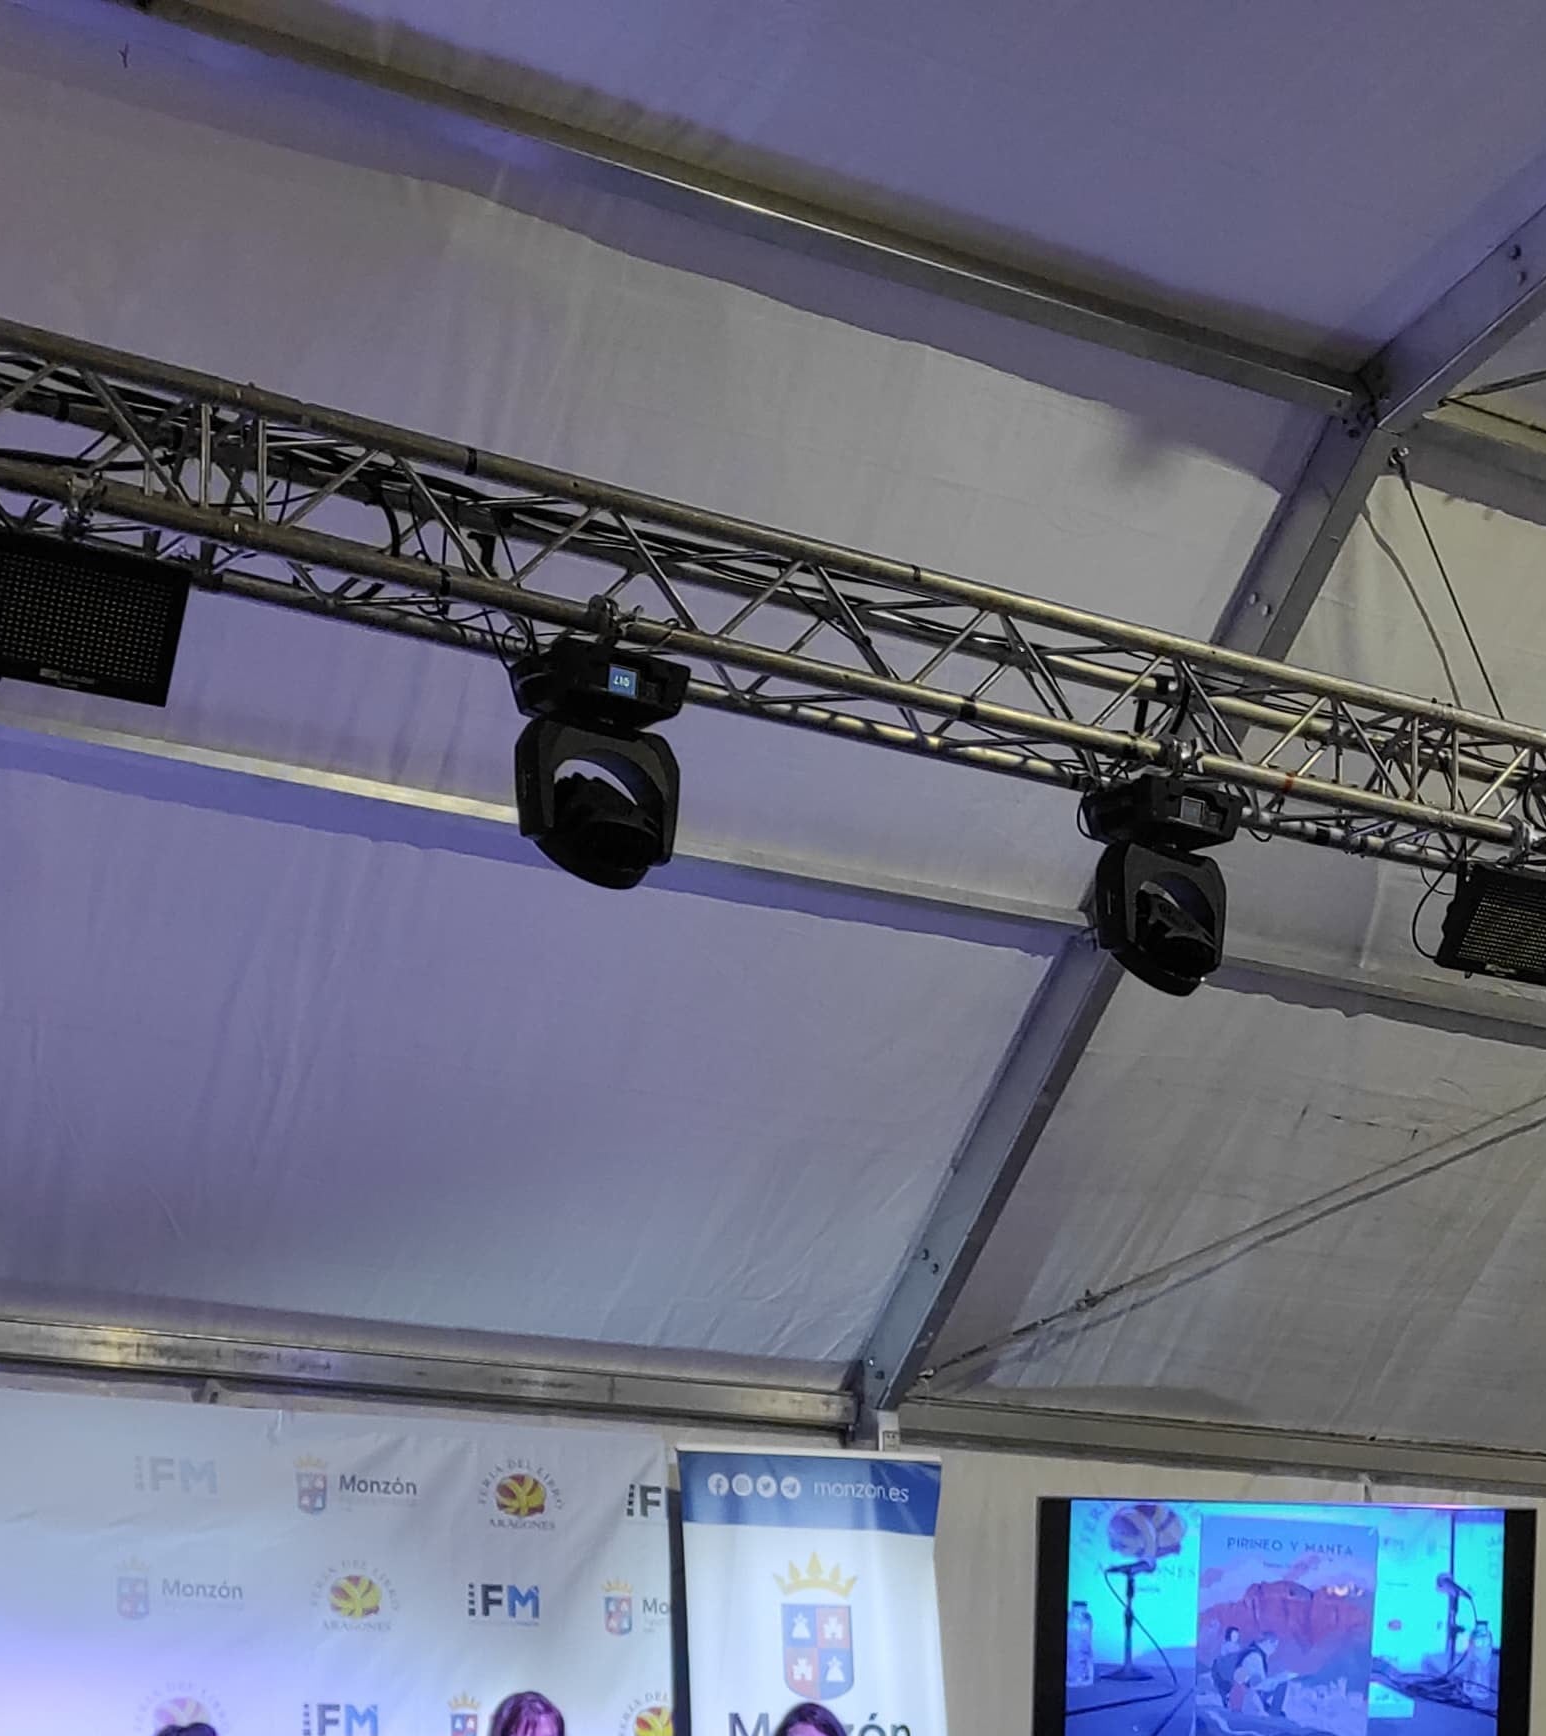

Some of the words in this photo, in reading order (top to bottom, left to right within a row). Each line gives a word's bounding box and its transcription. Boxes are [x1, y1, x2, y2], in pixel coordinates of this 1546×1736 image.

[338, 1473, 419, 1497] Monzón
[814, 1480, 910, 1503] monzon.es
[1289, 1540, 1299, 1552] Y
[161, 1577, 243, 1601] Monzón
